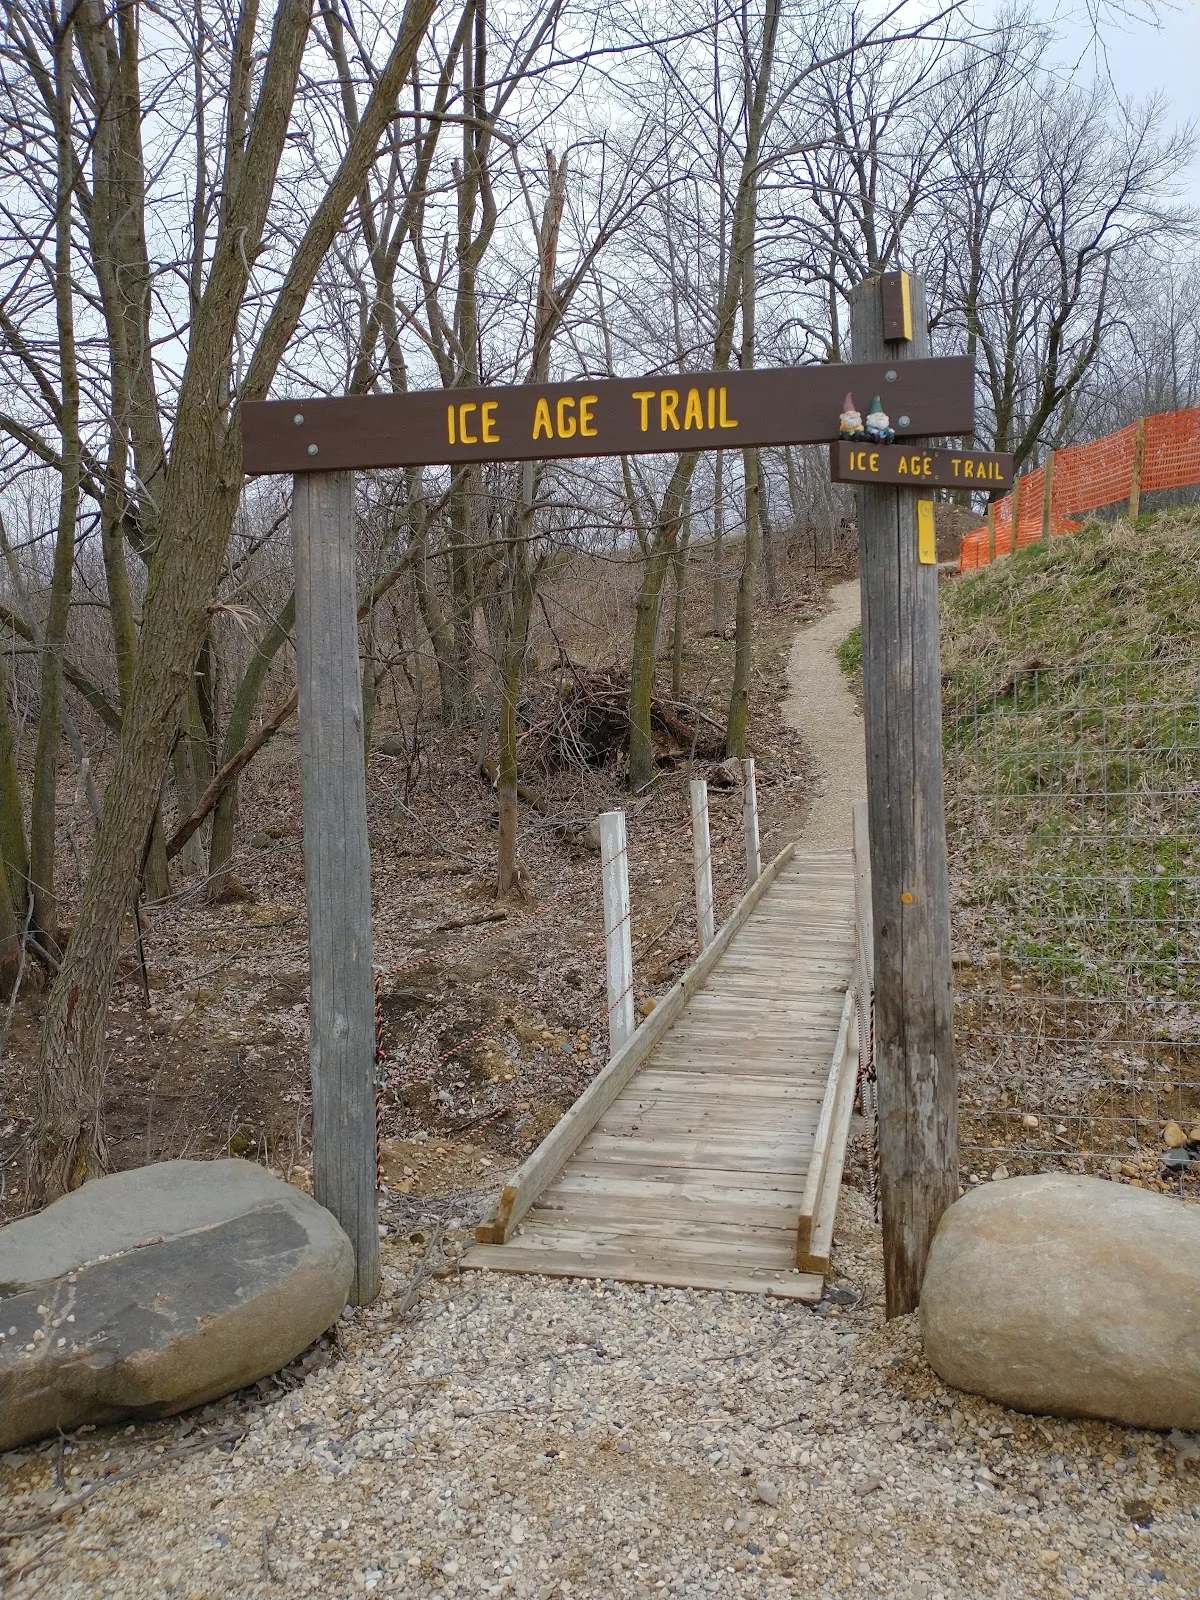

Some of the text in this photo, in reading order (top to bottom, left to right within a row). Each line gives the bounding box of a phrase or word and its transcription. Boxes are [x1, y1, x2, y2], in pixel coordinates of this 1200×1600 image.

[447, 386, 739, 445] ICE AGE TRAIL
[849, 451, 1004, 481] ICE AGE TRAIL
